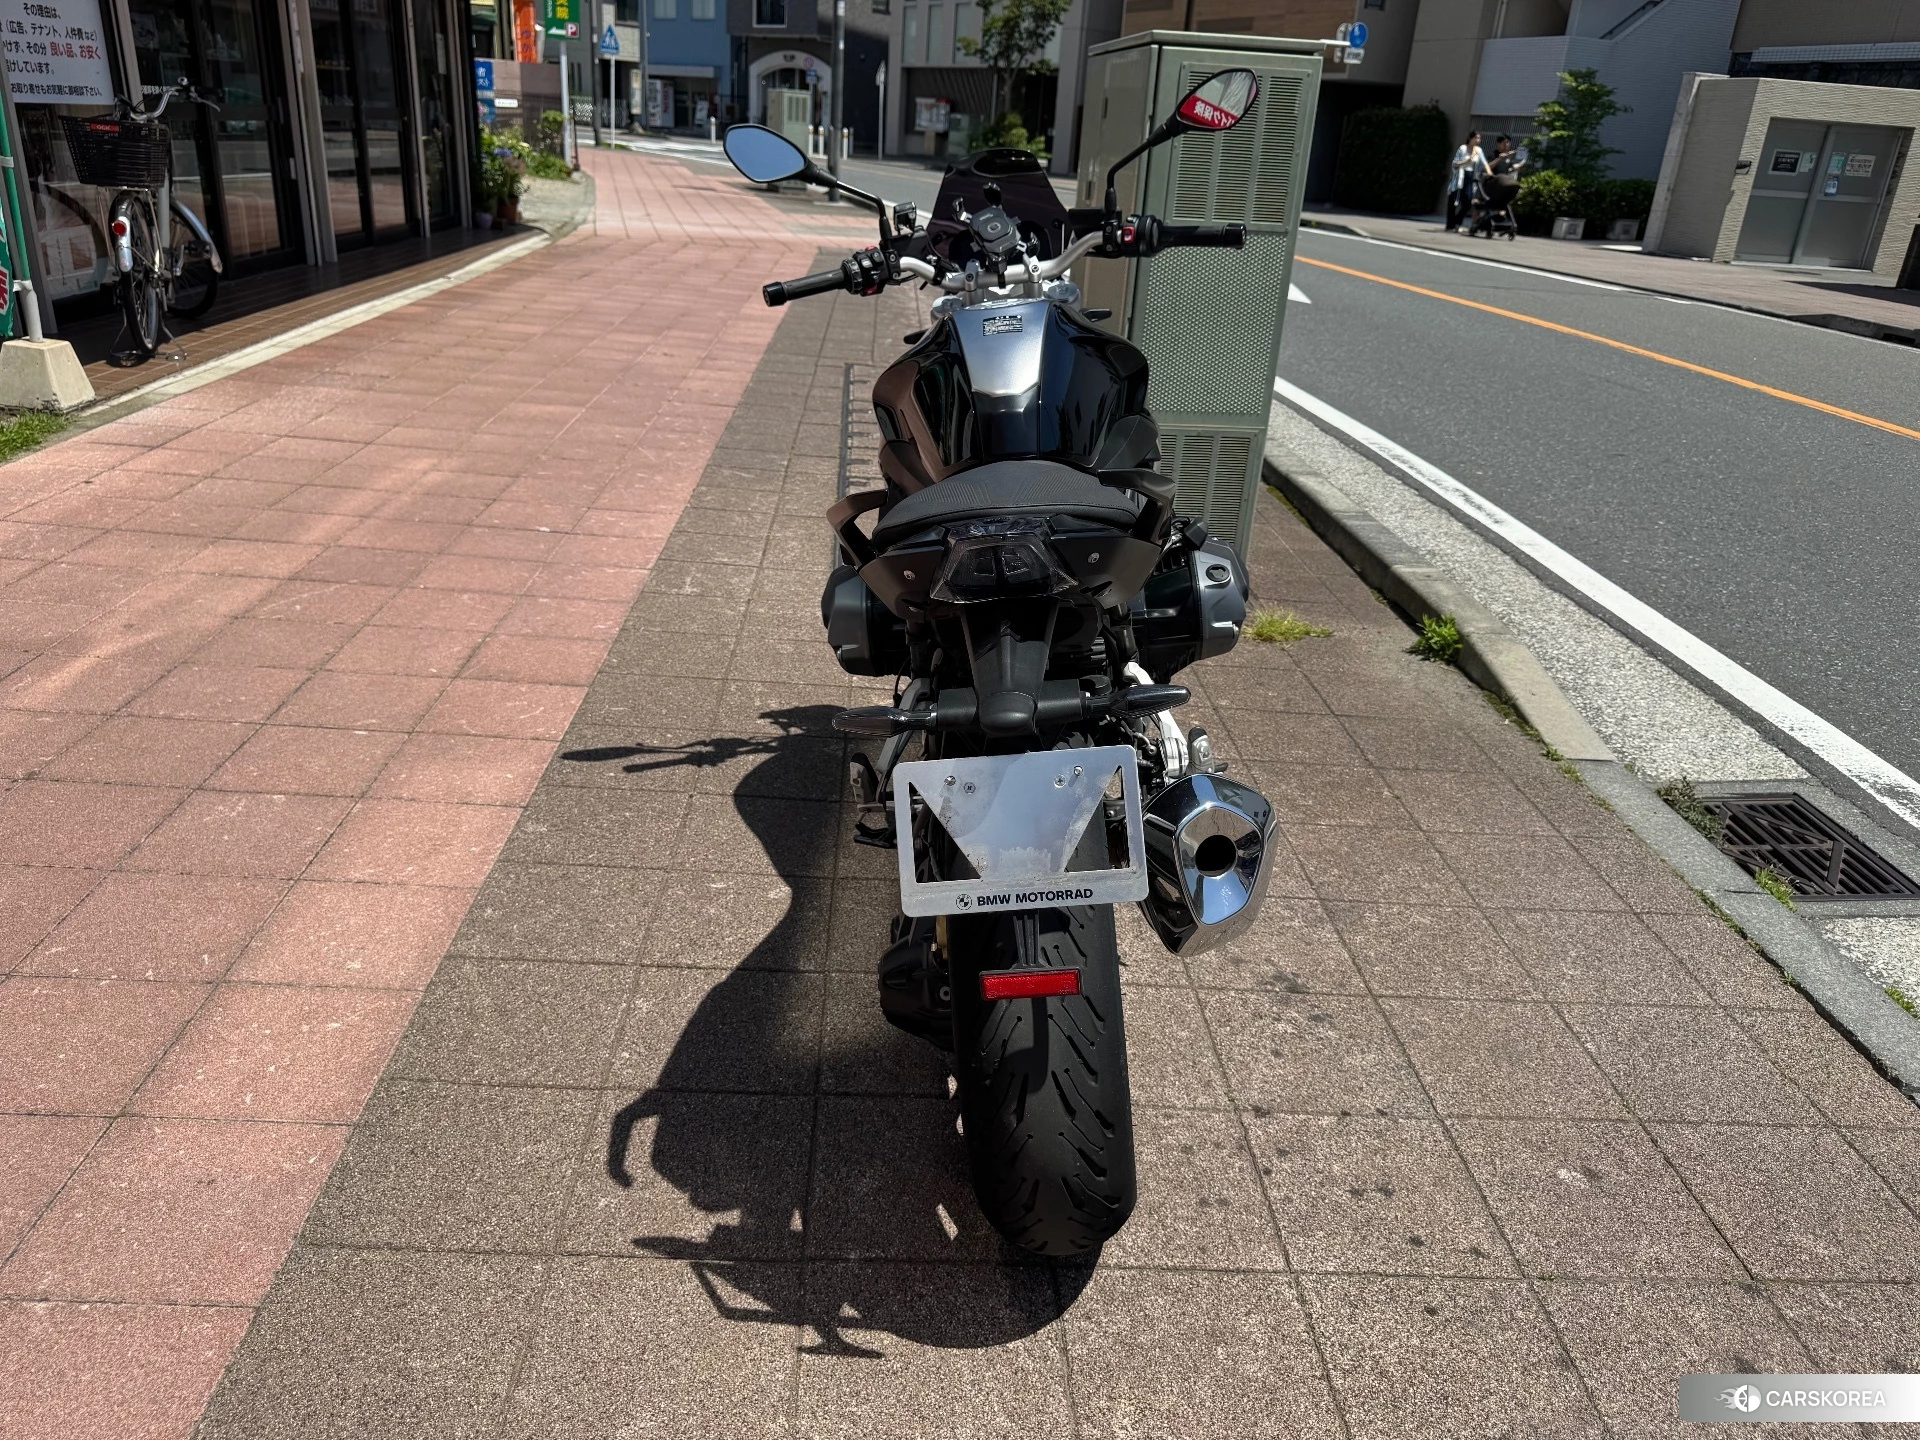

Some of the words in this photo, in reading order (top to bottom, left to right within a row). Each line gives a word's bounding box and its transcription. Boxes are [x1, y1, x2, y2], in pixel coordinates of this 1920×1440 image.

[23, 3, 61, 19] その理由は、
[50, 41, 101, 60] 良い品、お安く
[977, 894, 1011, 907] BMW
[1015, 888, 1094, 904] MOTORRAD
